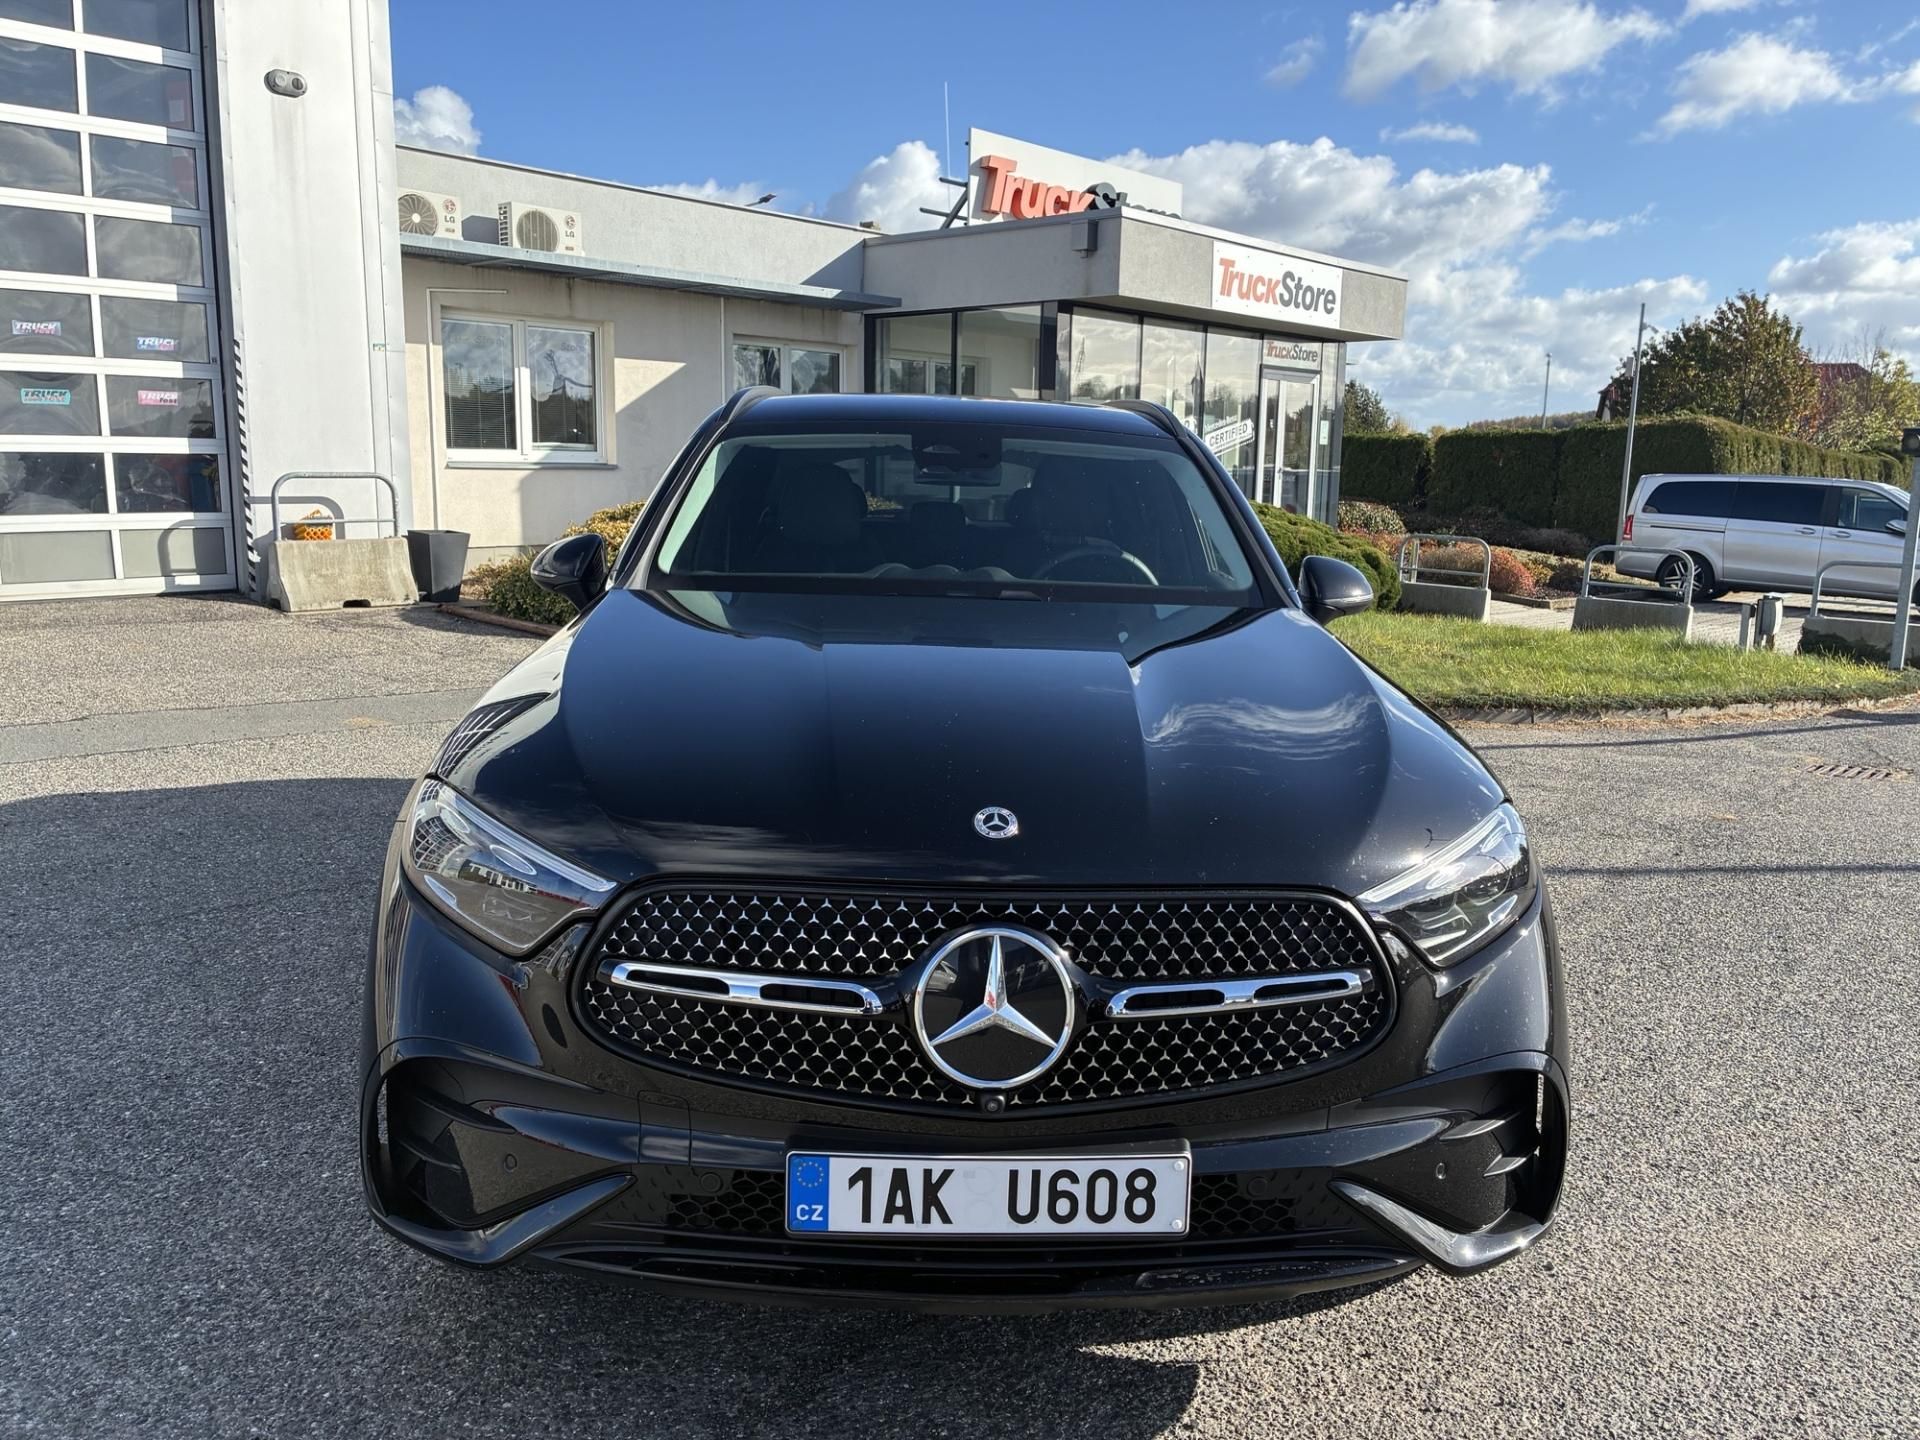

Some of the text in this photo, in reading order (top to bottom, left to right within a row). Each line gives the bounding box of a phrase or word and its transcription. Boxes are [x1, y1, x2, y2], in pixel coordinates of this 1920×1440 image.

[444, 215, 455, 224] LG
[565, 230, 575, 238] LG
[1219, 258, 1336, 315] TruckStore
[16, 321, 56, 330] TRUCK
[1266, 341, 1318, 362] TruckStore
[24, 390, 67, 398] TRUCK
[1209, 423, 1248, 447] CERTIFIED
[848, 1166, 1157, 1225] 1AK U608
[796, 1204, 823, 1221] CZ
